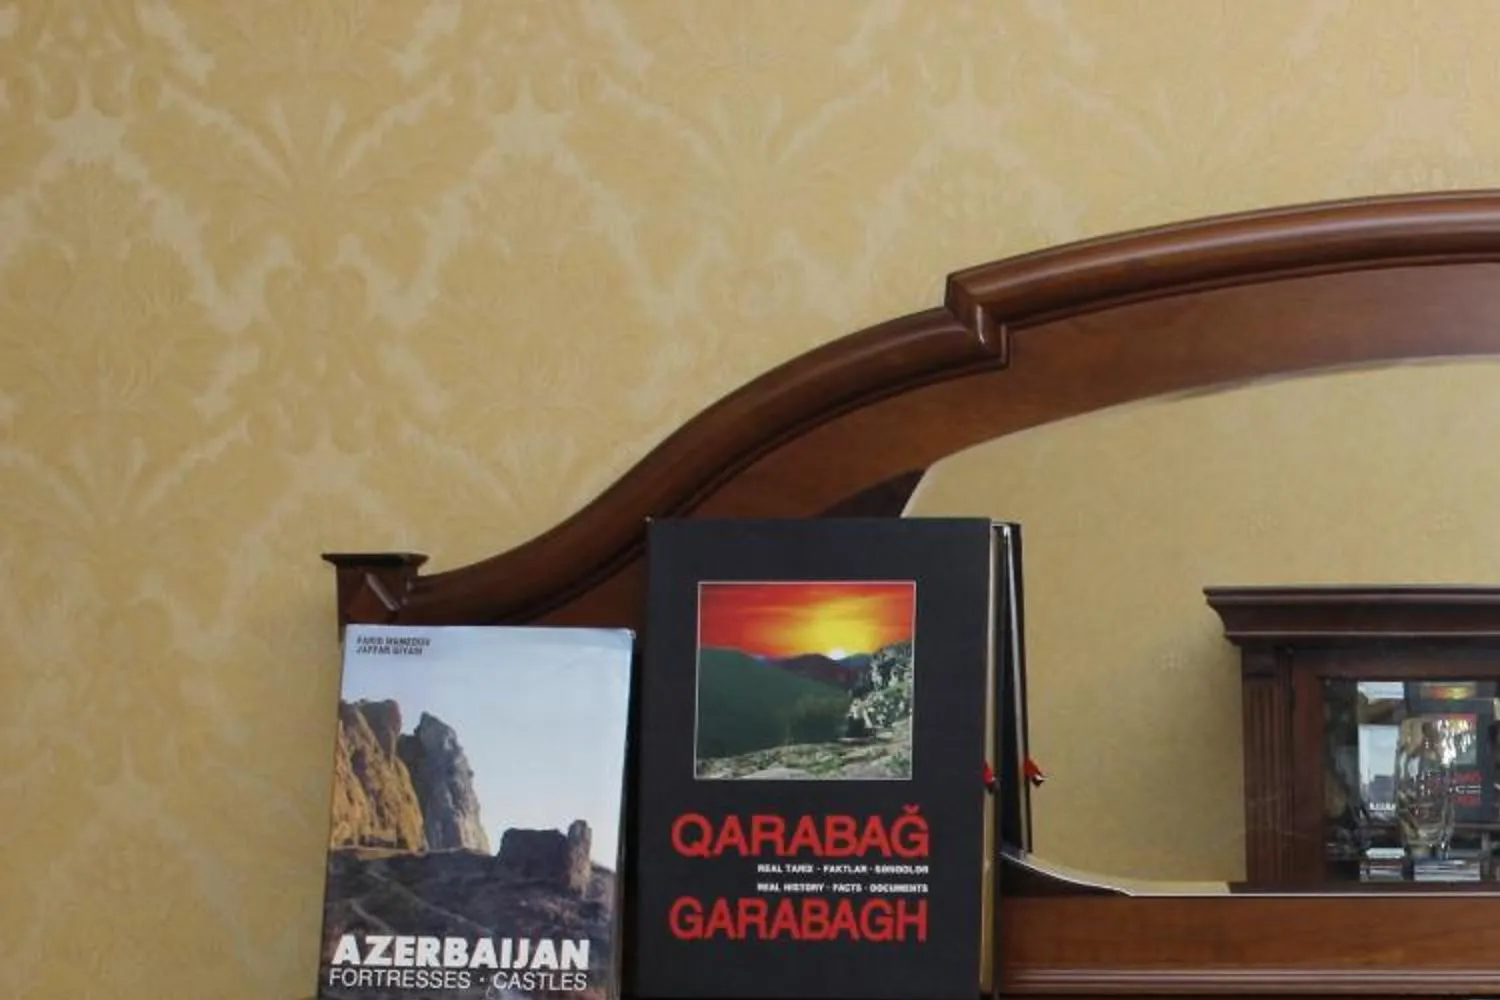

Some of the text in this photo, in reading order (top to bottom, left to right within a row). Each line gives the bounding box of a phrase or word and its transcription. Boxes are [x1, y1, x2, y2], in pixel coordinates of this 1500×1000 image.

[671, 805, 930, 858] QARABAĞ
[757, 863, 783, 873] REAL
[757, 882, 929, 894] REAL HISTORY FACTS DOCUMENTS
[669, 896, 927, 942] GARABAGH
[331, 934, 591, 971] AZERBAIJAN
[329, 967, 588, 992] FORTRESSES CASTLES
